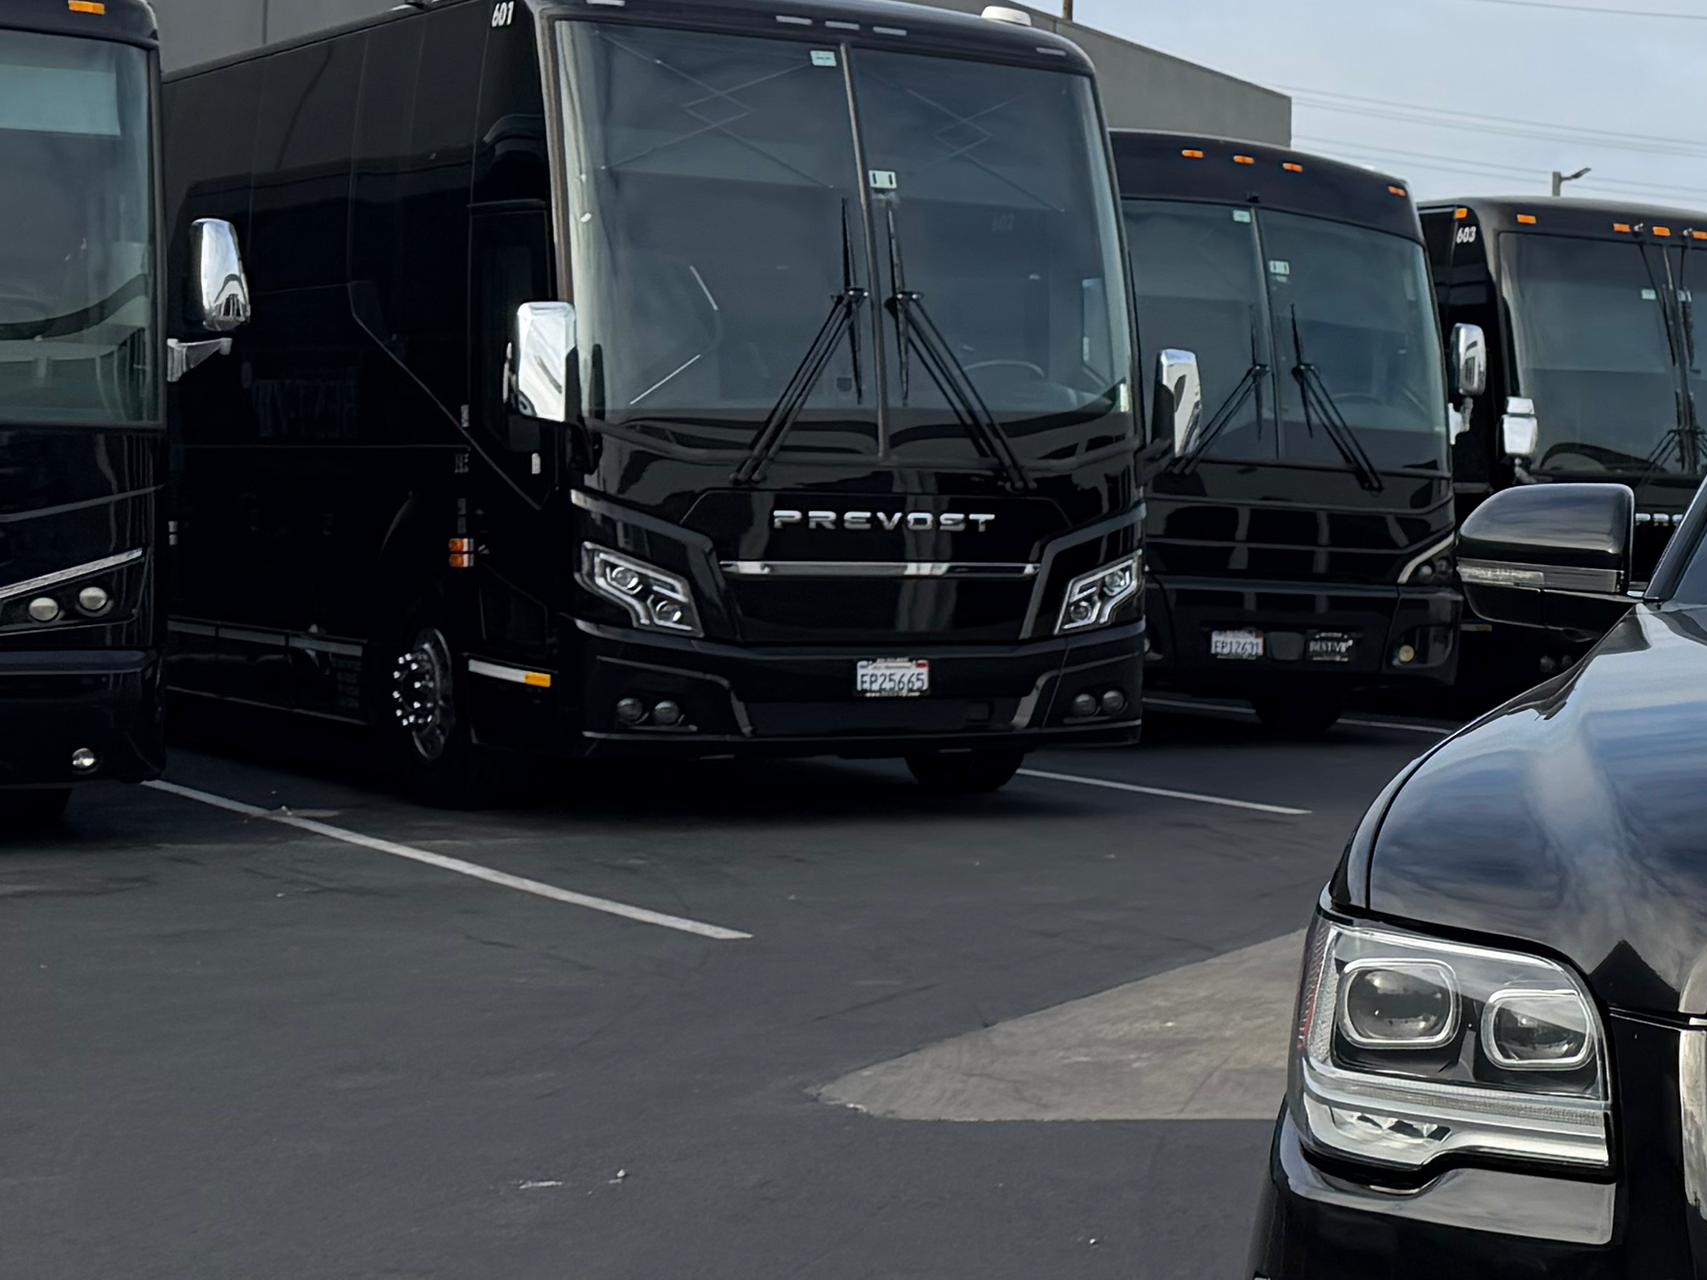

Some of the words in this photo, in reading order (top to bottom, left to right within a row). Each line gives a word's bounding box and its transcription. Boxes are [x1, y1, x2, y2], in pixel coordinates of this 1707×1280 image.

[491, 0, 515, 28] 601
[1456, 225, 1477, 244] 603
[772, 509, 996, 533] PREVOST
[860, 672, 925, 692] EP25665
